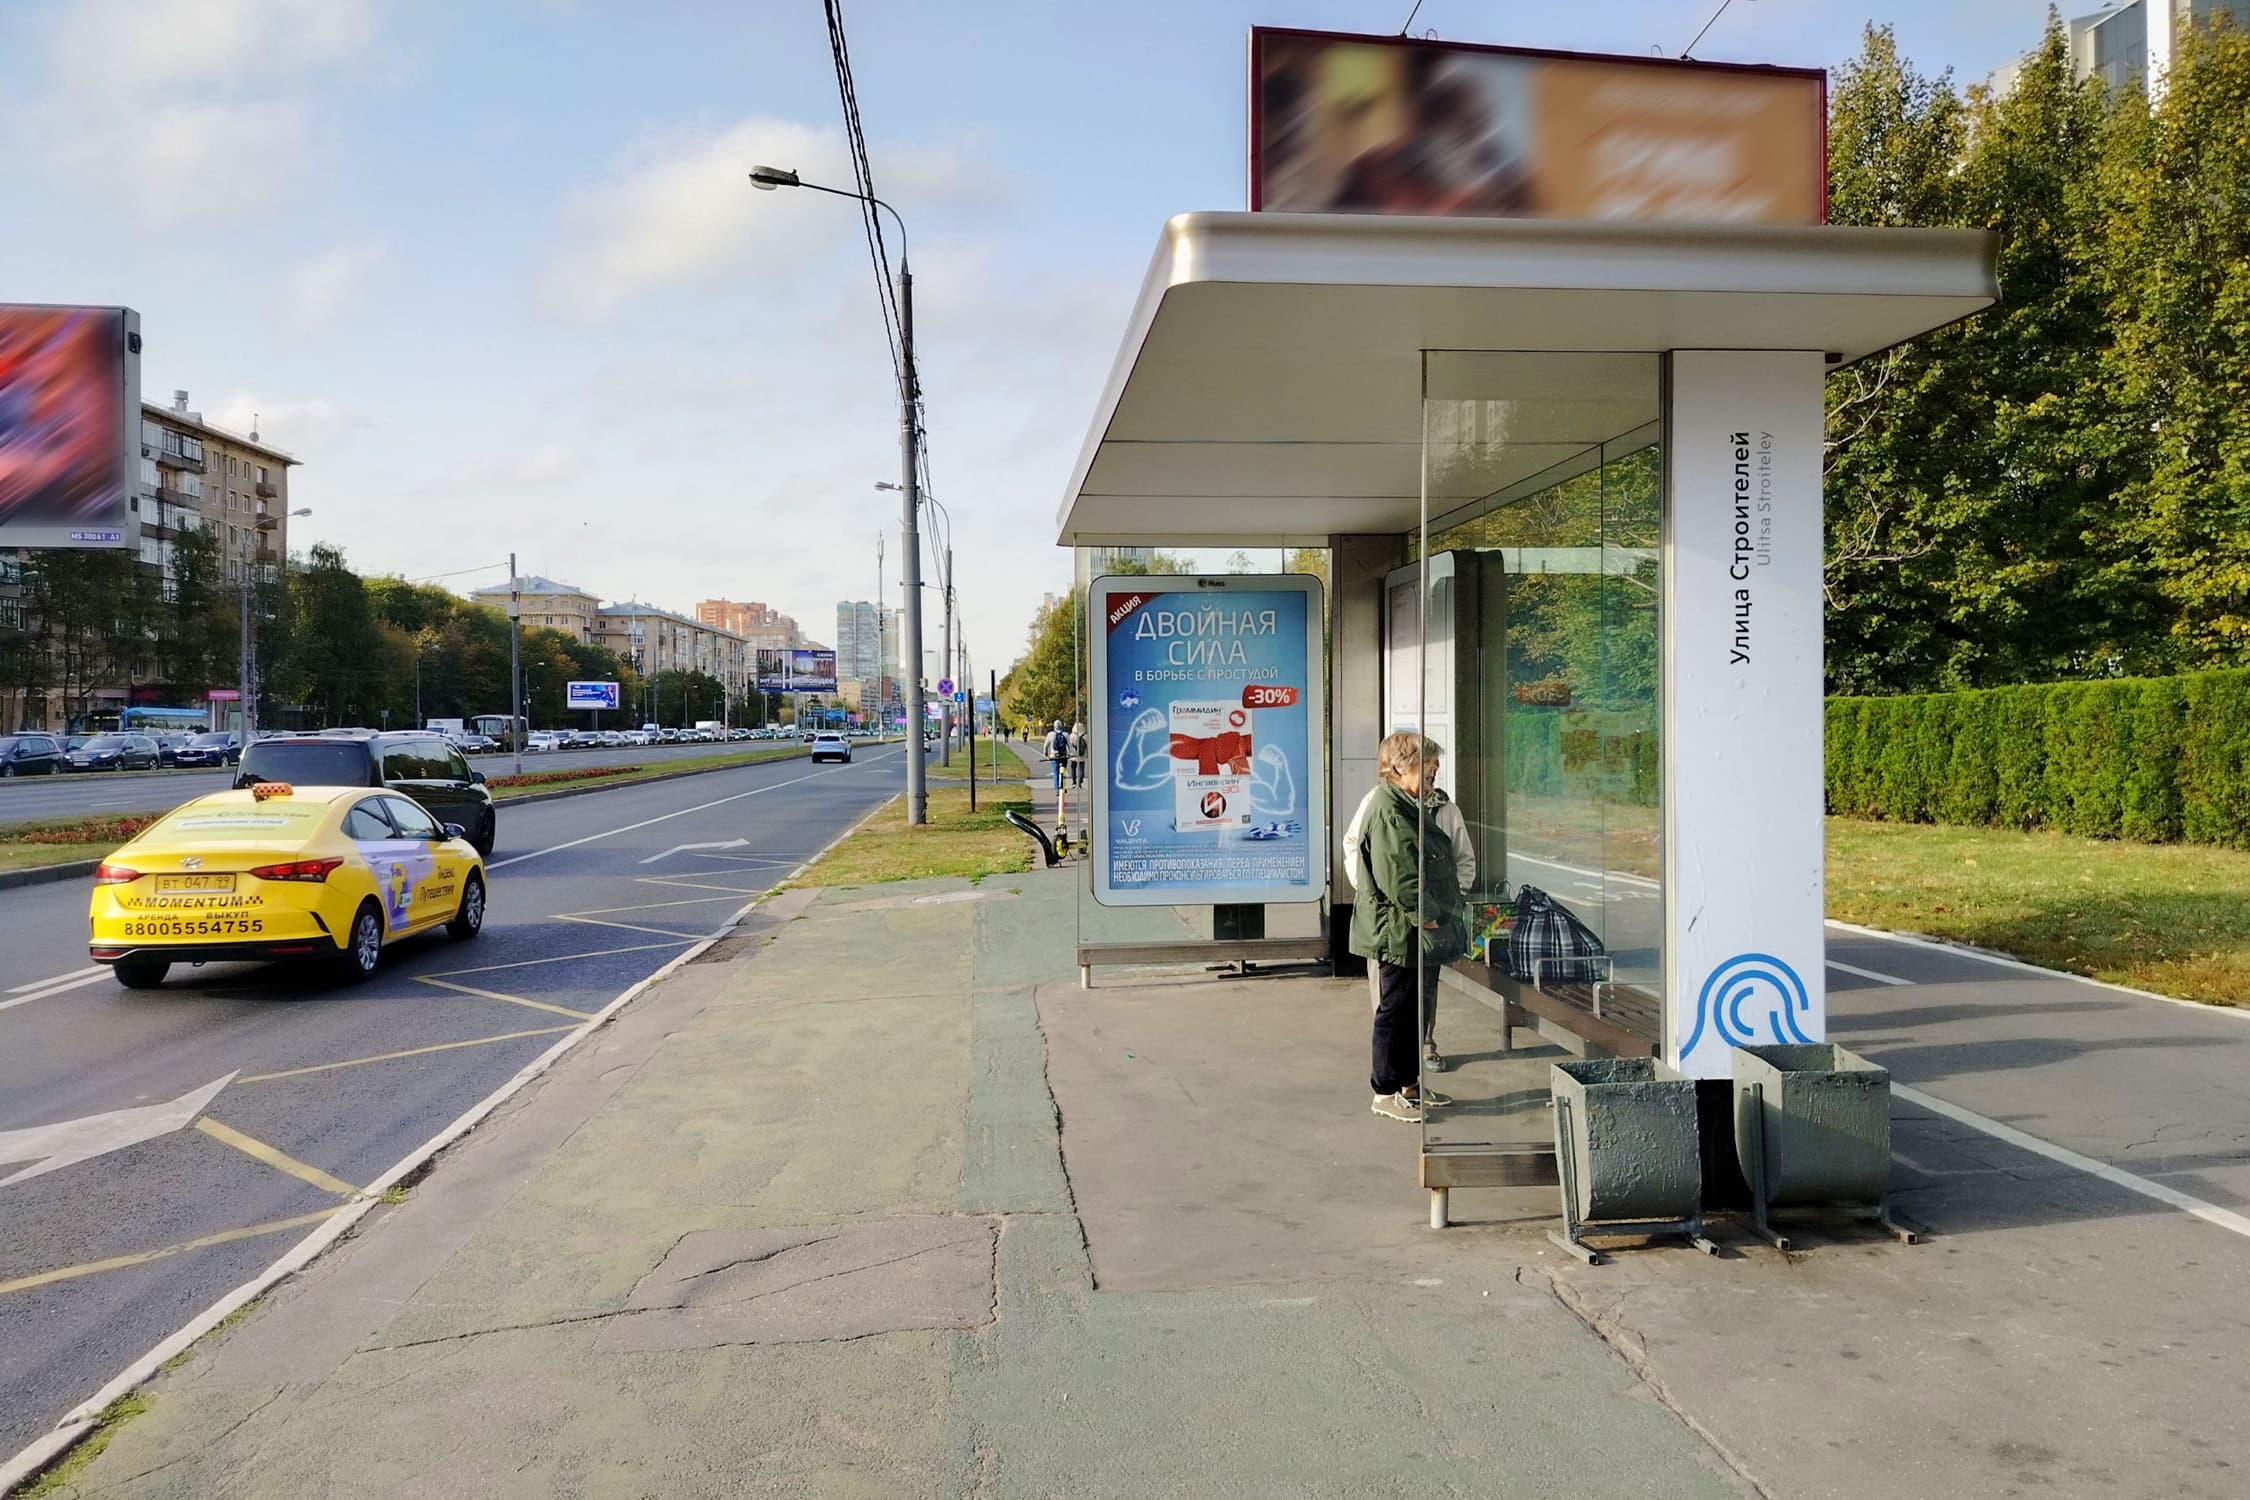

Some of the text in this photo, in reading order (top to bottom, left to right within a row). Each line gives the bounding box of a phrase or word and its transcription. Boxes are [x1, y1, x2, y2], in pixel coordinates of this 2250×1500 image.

[1757, 431, 1774, 566] Ulitsa Stroiteley
[1730, 431, 1753, 665] Улица Строителей
[1109, 595, 1142, 625] АКЦИЯ
[1135, 604, 1277, 640] ДВОЙНАЯ
[1168, 639, 1247, 666] СИЛА
[1135, 666, 1278, 681] В БОРЬБЕ С ПРОСТУДОЙ
[1113, 859, 1147, 871] ИМЕЮТСЯ
[185, 877, 209, 888] 047
[1113, 870, 1158, 882] НЕОБХОДИМО
[144, 895, 244, 908] MOMENTUM
[137, 911, 249, 921] АРЕНДА ВЫКУП
[124, 919, 263, 936] 88005554755
